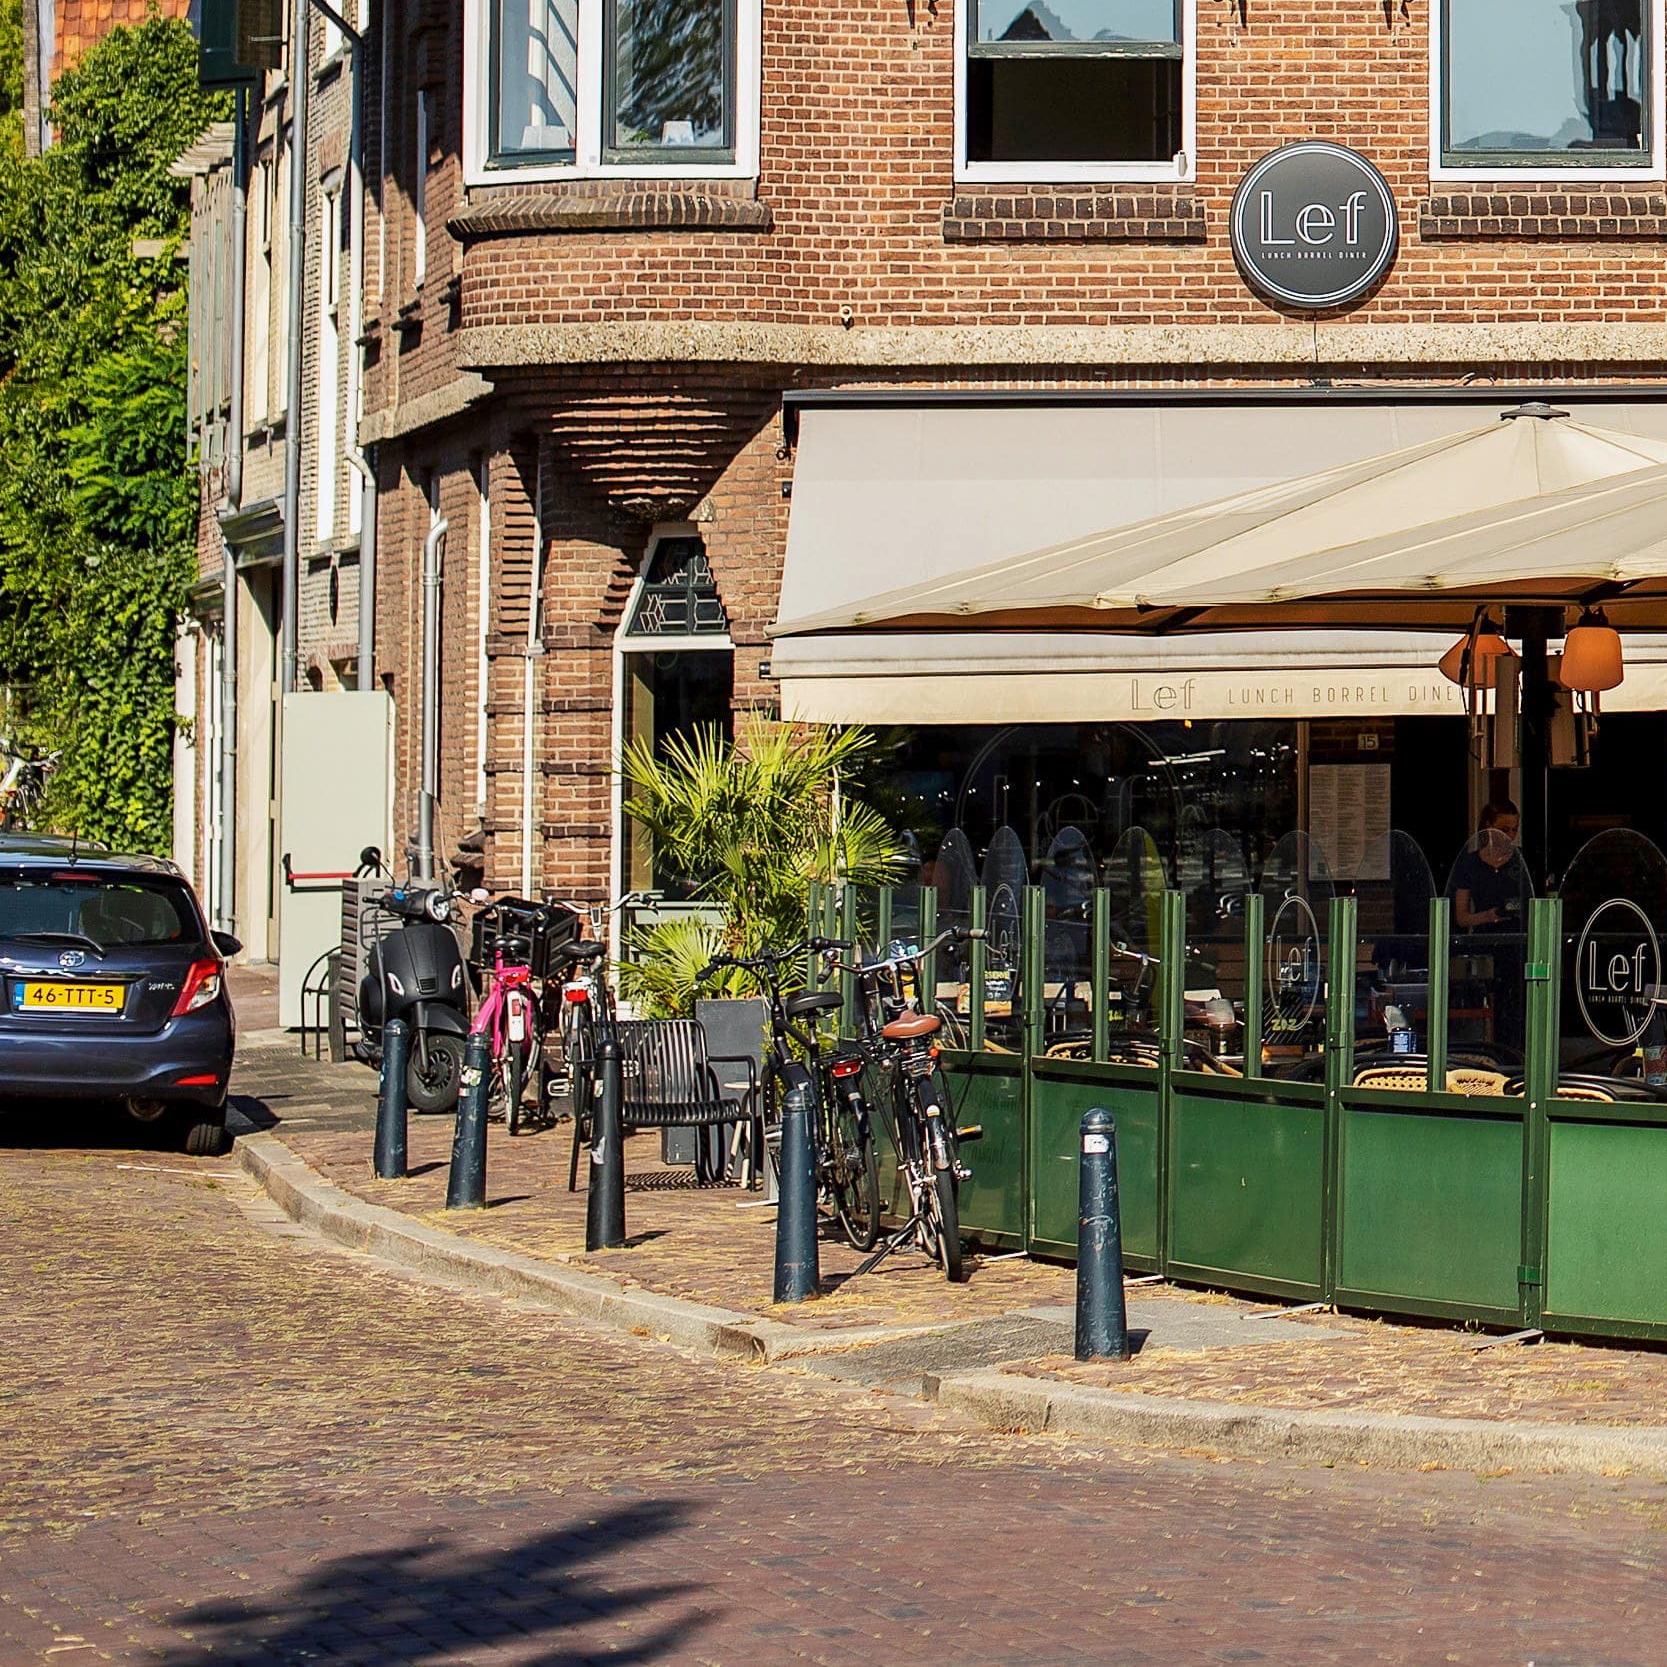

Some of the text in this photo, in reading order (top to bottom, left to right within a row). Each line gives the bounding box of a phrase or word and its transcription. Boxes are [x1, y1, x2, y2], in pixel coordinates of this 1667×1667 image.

[1260, 191, 1368, 245] Lef
[1261, 252, 1367, 260] LUNCH BORREL DINER
[1131, 678, 1463, 710] Lef LUNCH BORREL DINE
[1362, 735, 1376, 749] 15
[1276, 935, 1313, 982] Lef
[1589, 940, 1648, 993] Lef
[33, 988, 115, 1005] 46-TTT-5
